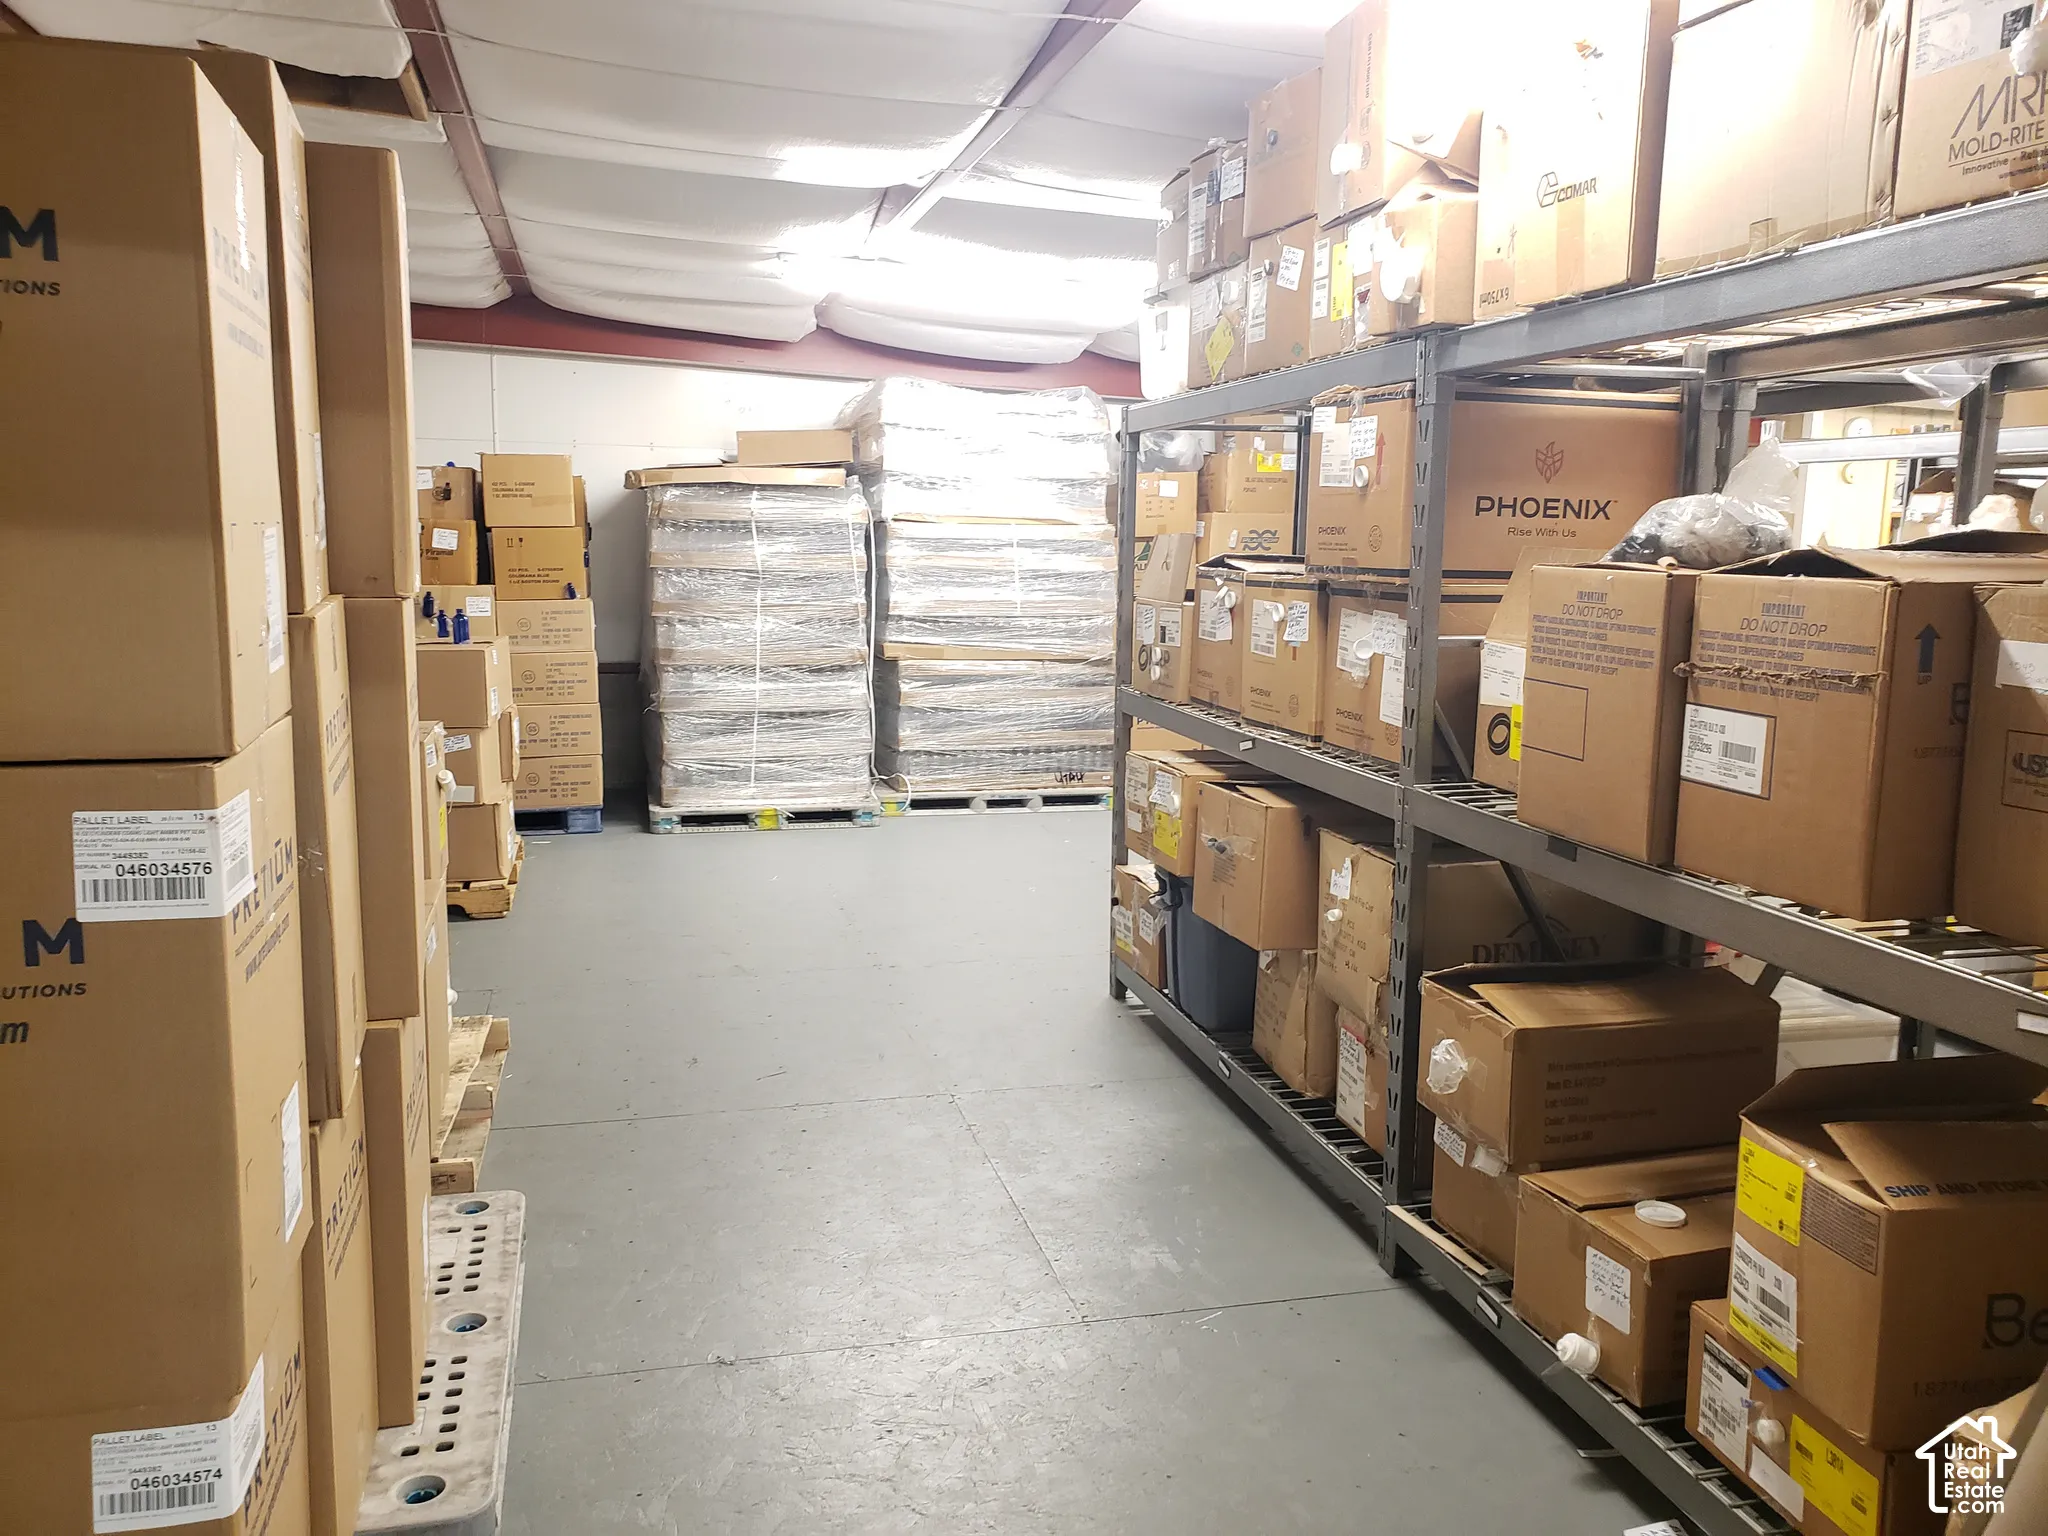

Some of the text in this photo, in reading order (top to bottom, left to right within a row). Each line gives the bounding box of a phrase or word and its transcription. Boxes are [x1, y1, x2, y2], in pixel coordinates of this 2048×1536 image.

[1949, 120, 2046, 162] MOLD-RITE
[1962, 158, 2009, 175] Innovative
[1557, 177, 1598, 203] COMAR
[1475, 495, 1612, 520] PHOENIX
[1318, 526, 1346, 536] PHOENIX
[1508, 527, 1577, 538] Rise With Us
[1562, 604, 1623, 620] DO NOT DROP
[1740, 618, 1828, 637] DO NOT DROP
[1335, 708, 1364, 723] PHOENIX
[74, 816, 152, 825] PALLET LABEL
[193, 813, 205, 821] 13
[115, 861, 213, 877] 046034576
[1884, 1183, 1931, 1198] SHIP
[1936, 1182, 1978, 1196] AND
[206, 1423, 217, 1431] 13
[94, 1432, 166, 1445] PALLET LABEL
[130, 1467, 222, 1490] 046034574
